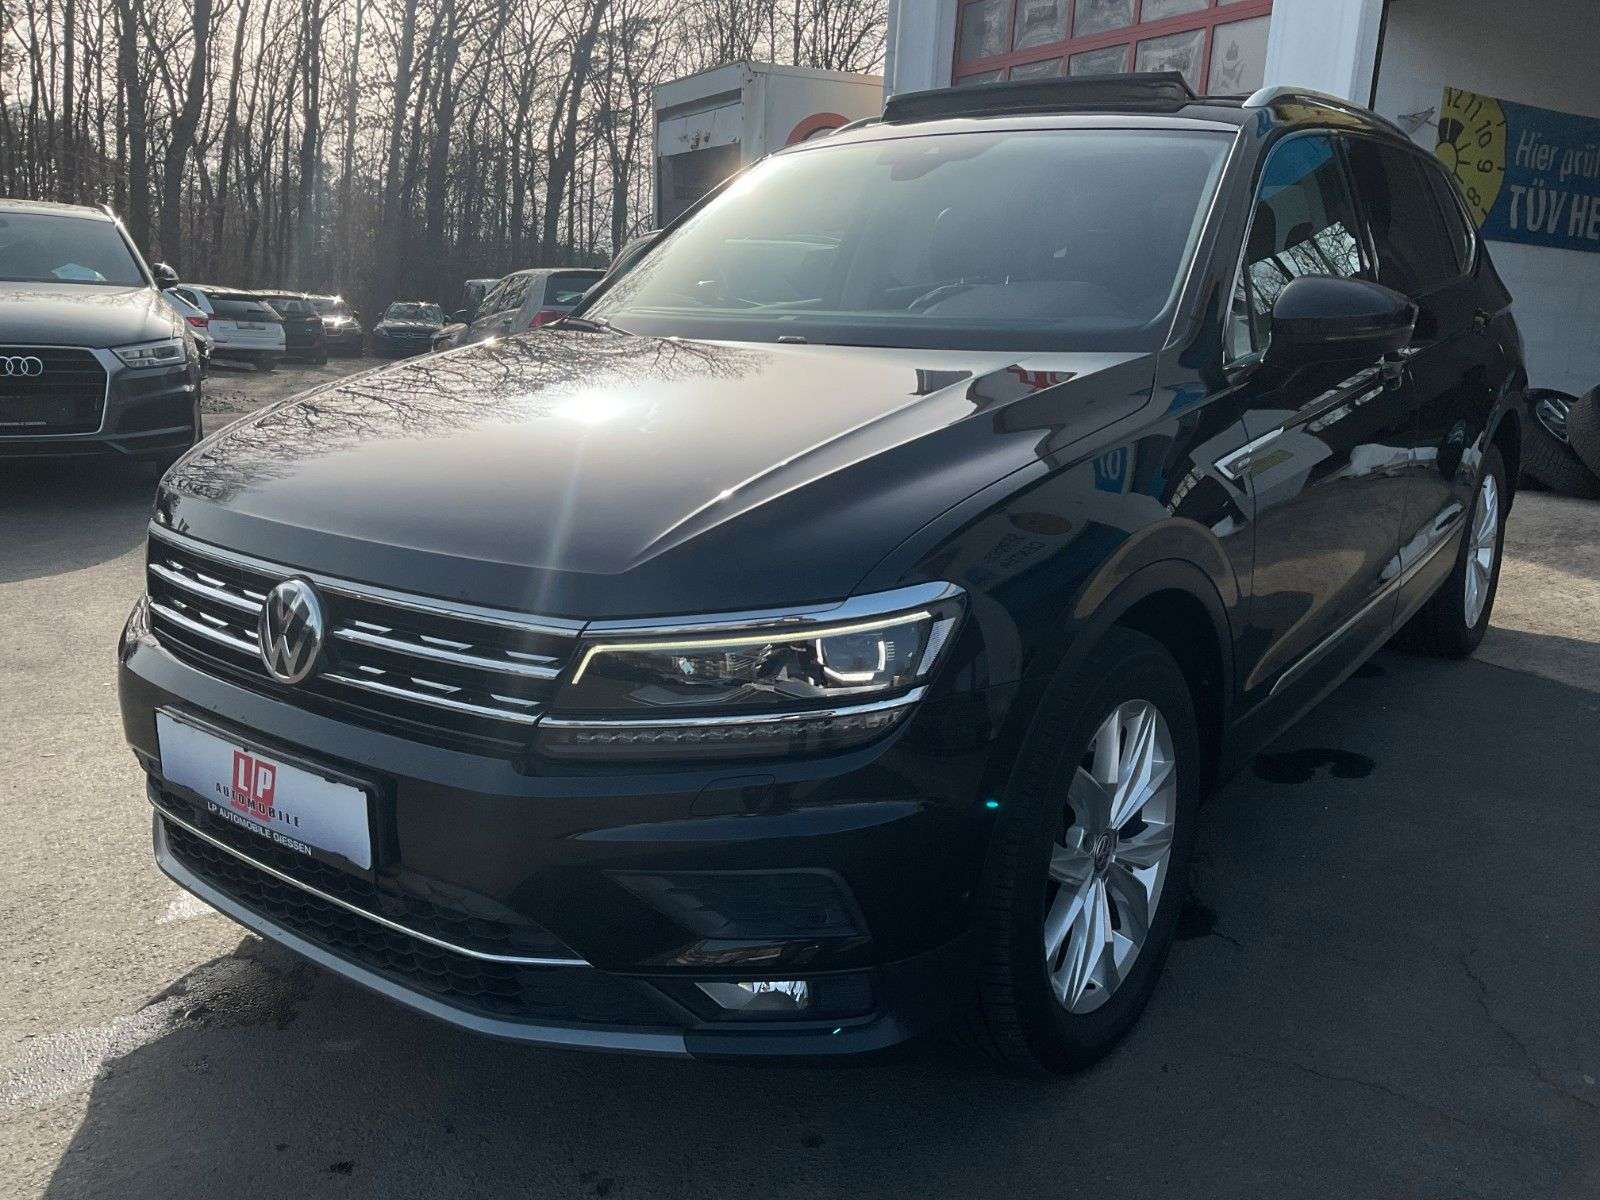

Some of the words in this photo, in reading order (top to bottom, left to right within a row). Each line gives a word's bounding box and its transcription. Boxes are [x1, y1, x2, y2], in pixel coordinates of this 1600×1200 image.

[1475, 120, 1493, 148] 10
[1515, 128, 1559, 172] Hier
[1476, 159, 1494, 174] 9
[1466, 186, 1482, 207] 8
[1509, 178, 1568, 235] TÜV
[207, 801, 218, 812] LP
[219, 807, 272, 839] AUTOMOBILE
